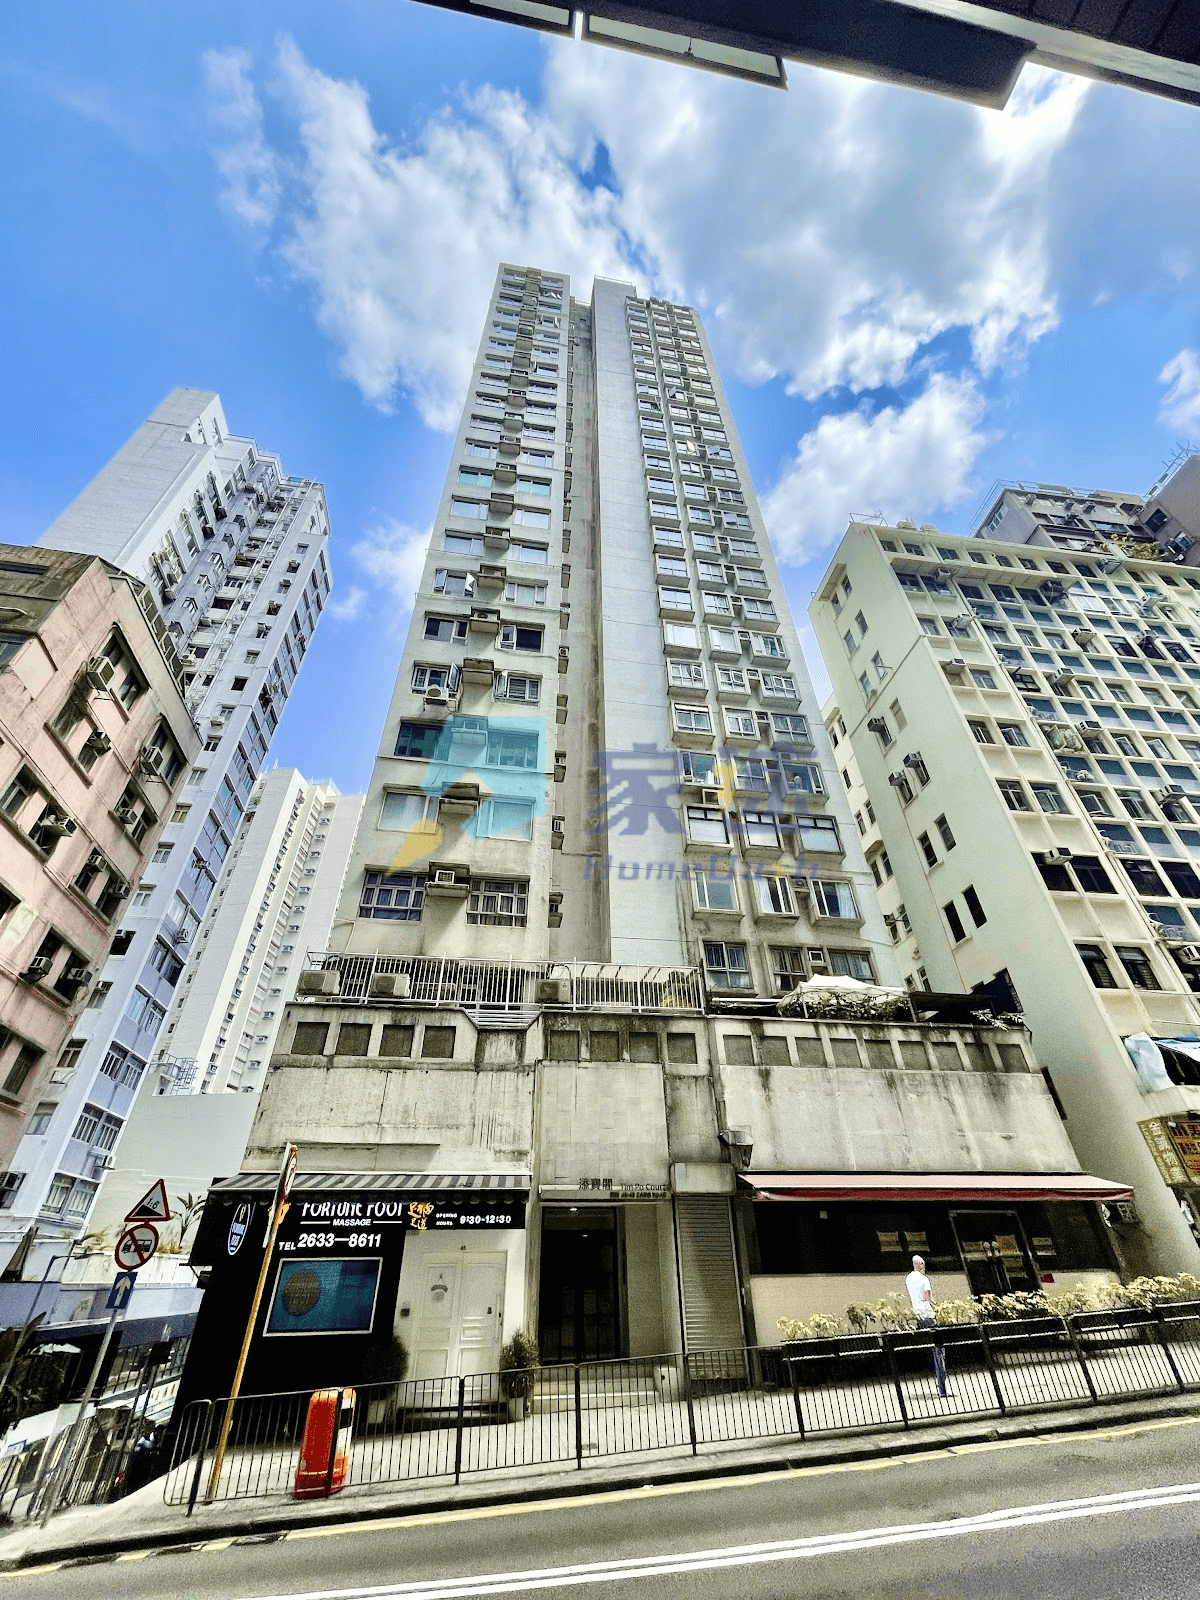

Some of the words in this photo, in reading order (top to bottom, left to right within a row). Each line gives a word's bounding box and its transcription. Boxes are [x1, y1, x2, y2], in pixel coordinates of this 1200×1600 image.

[332, 1218, 371, 1226] MASSAGE
[460, 1215, 511, 1224] 9:30-12:30
[278, 1241, 296, 1250] TEL
